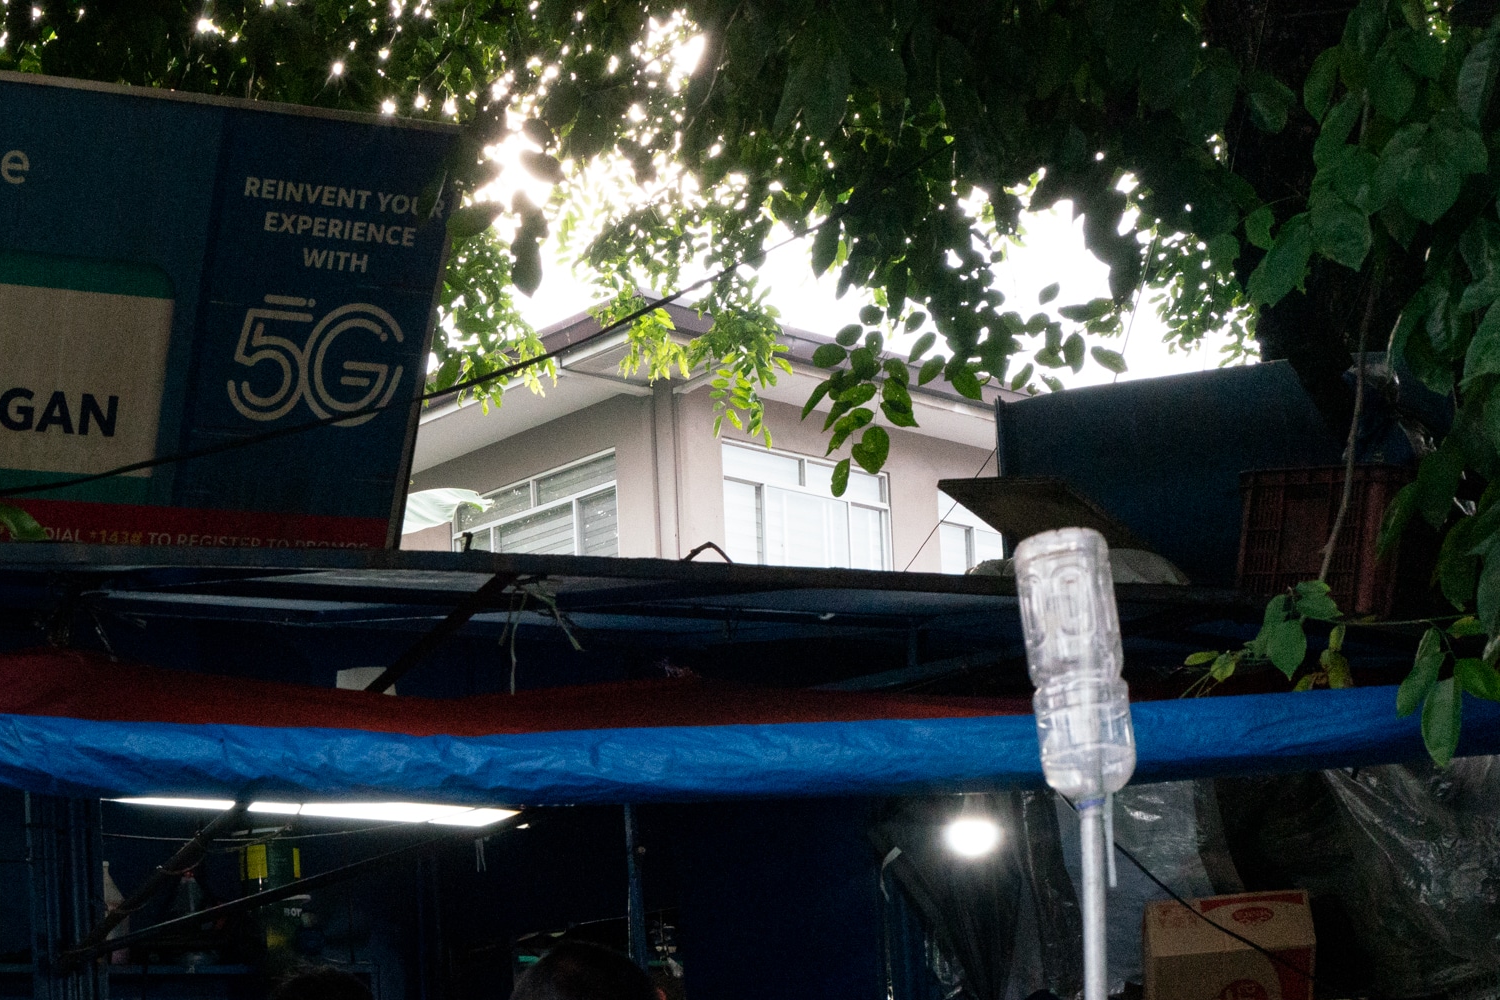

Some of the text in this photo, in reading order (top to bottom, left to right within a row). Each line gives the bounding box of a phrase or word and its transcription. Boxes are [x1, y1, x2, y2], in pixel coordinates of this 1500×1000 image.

[243, 176, 372, 211] REINVENT
[263, 211, 418, 247] EXPERIENCE
[302, 247, 369, 273] WITH
[226, 293, 405, 428] 5G
